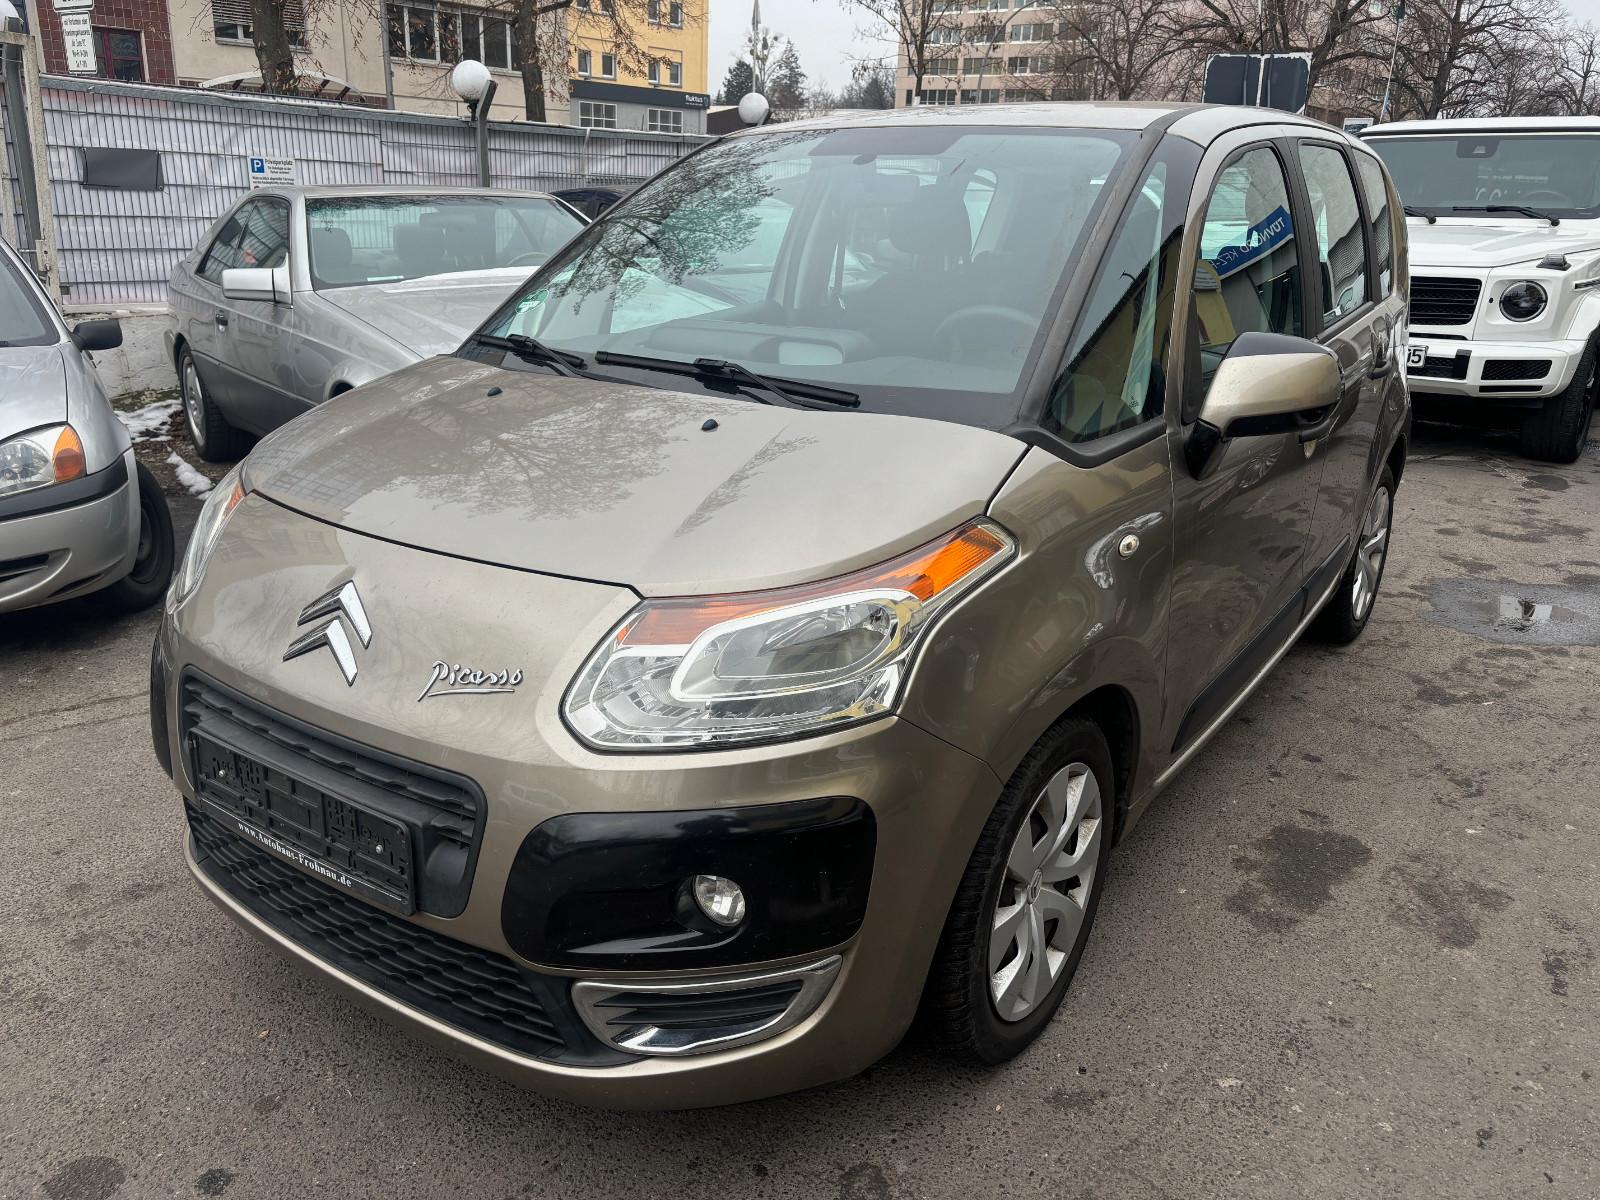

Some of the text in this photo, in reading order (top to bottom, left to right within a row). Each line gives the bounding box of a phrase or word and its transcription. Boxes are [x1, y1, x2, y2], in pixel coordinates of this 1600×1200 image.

[253, 159, 262, 172] P
[417, 660, 523, 702] Picasso
[238, 822, 352, 888] www.Autohaus-Frohnau.de
